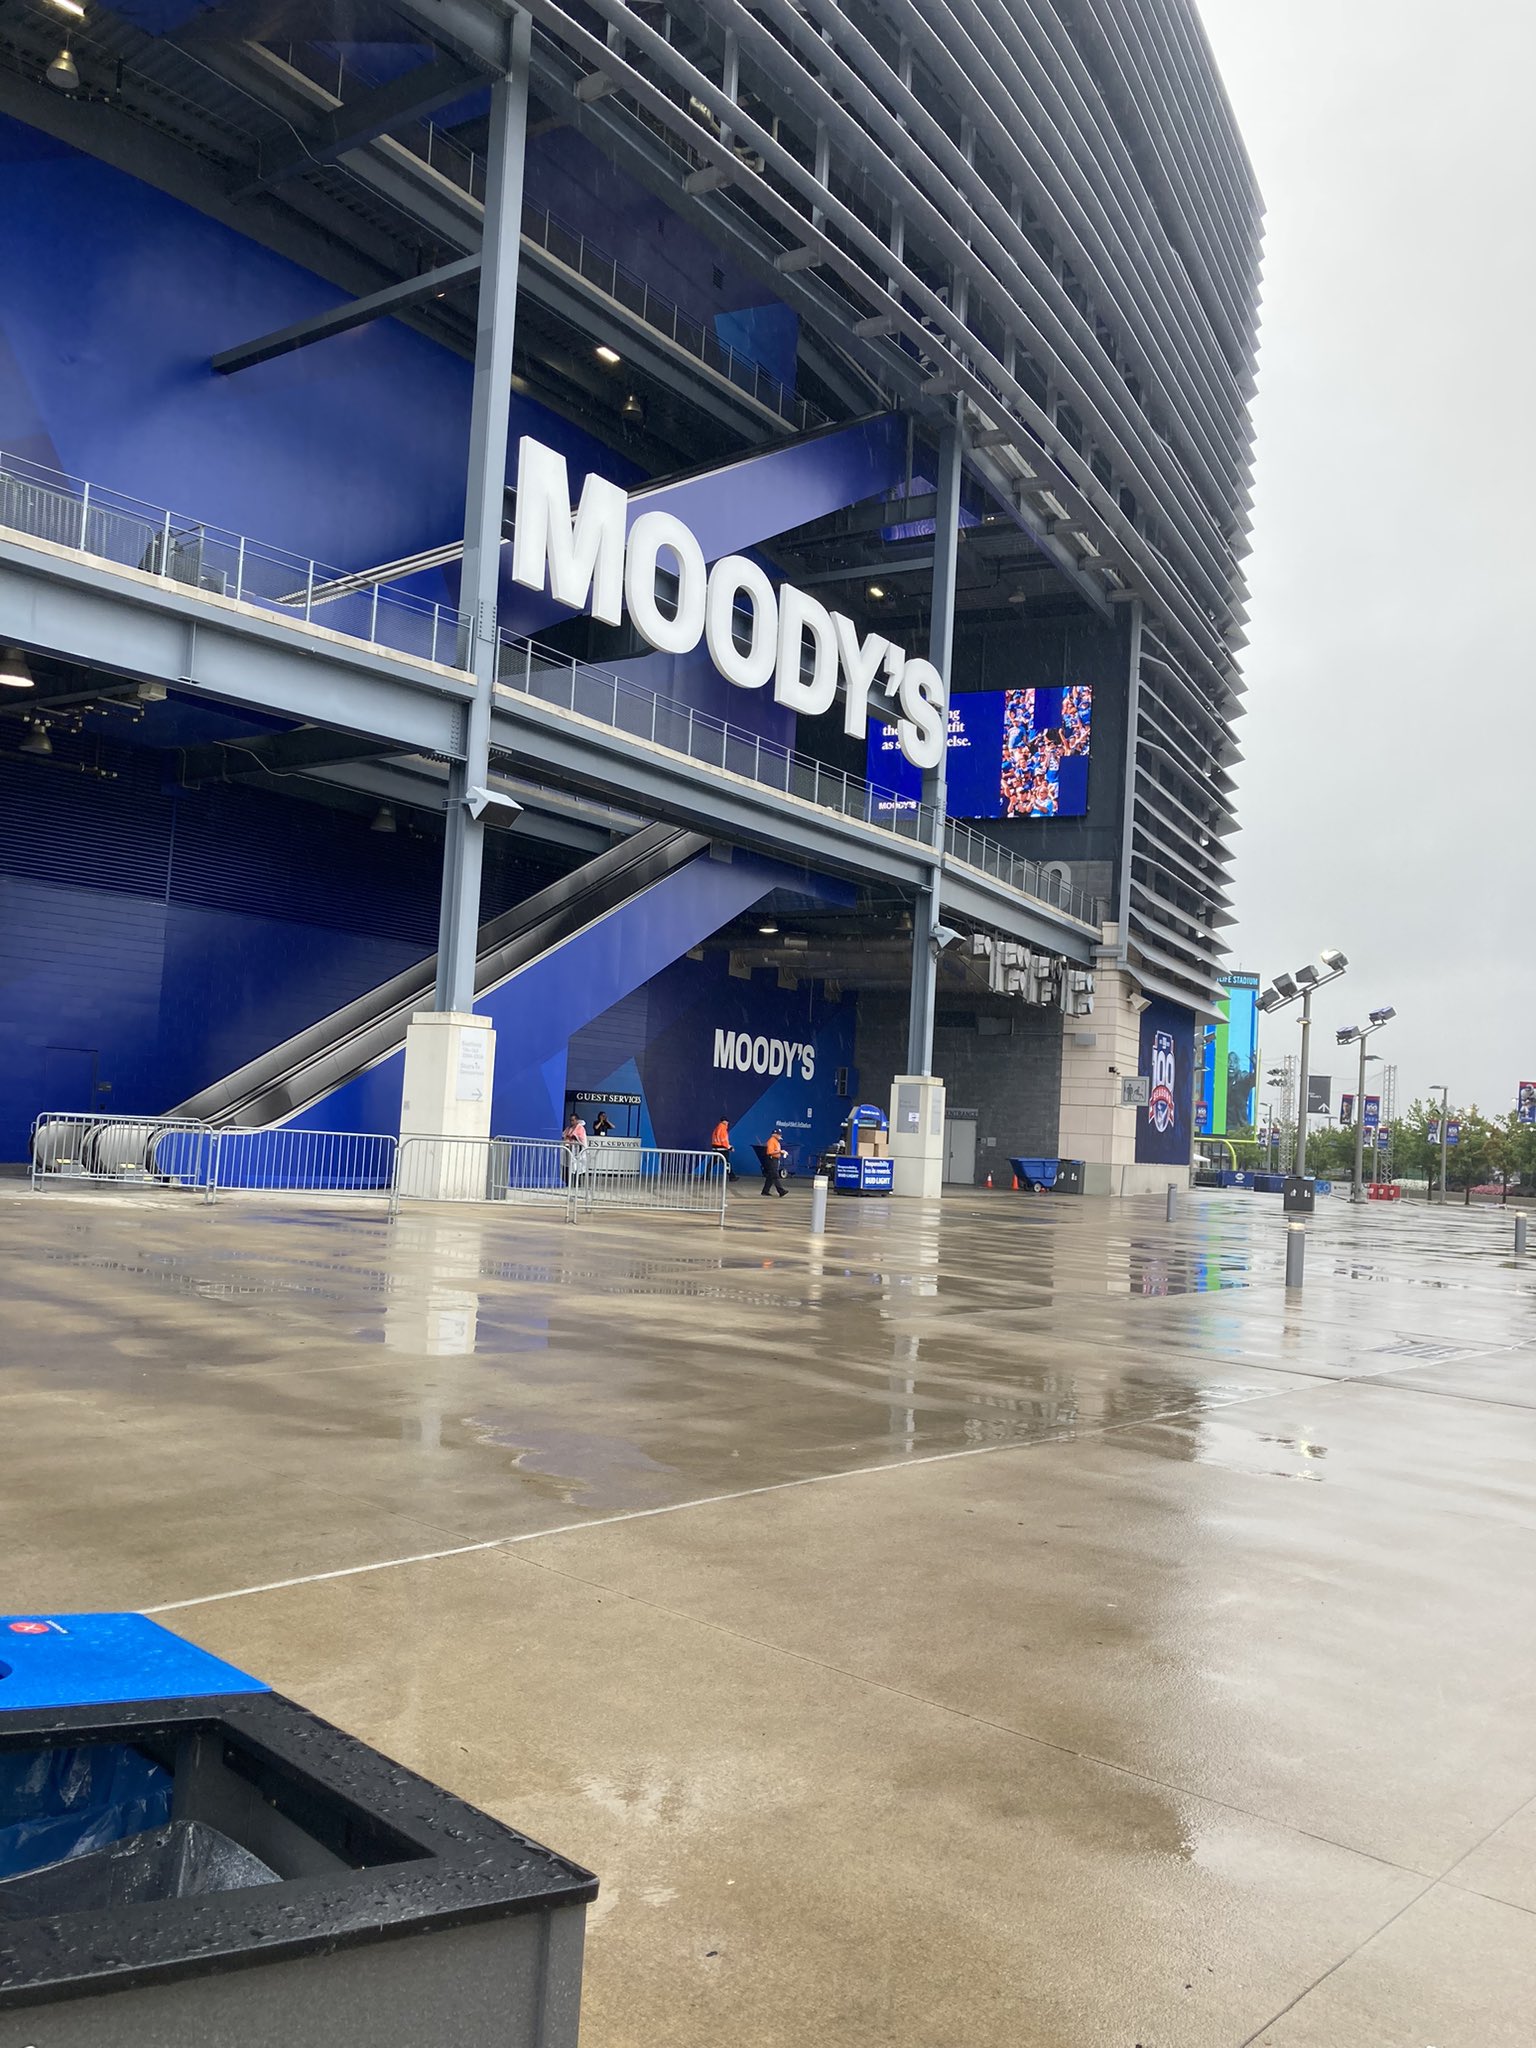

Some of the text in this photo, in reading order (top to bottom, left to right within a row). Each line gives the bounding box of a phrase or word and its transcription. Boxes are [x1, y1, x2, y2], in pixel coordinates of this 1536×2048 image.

[512, 435, 946, 769] MOODY'S
[881, 741, 894, 750] as
[946, 735, 972, 747] else.
[1232, 976, 1258, 985] STADIUM
[713, 1028, 815, 1080] MOODY'S
[576, 1092, 642, 1104] GUEST SERVICES
